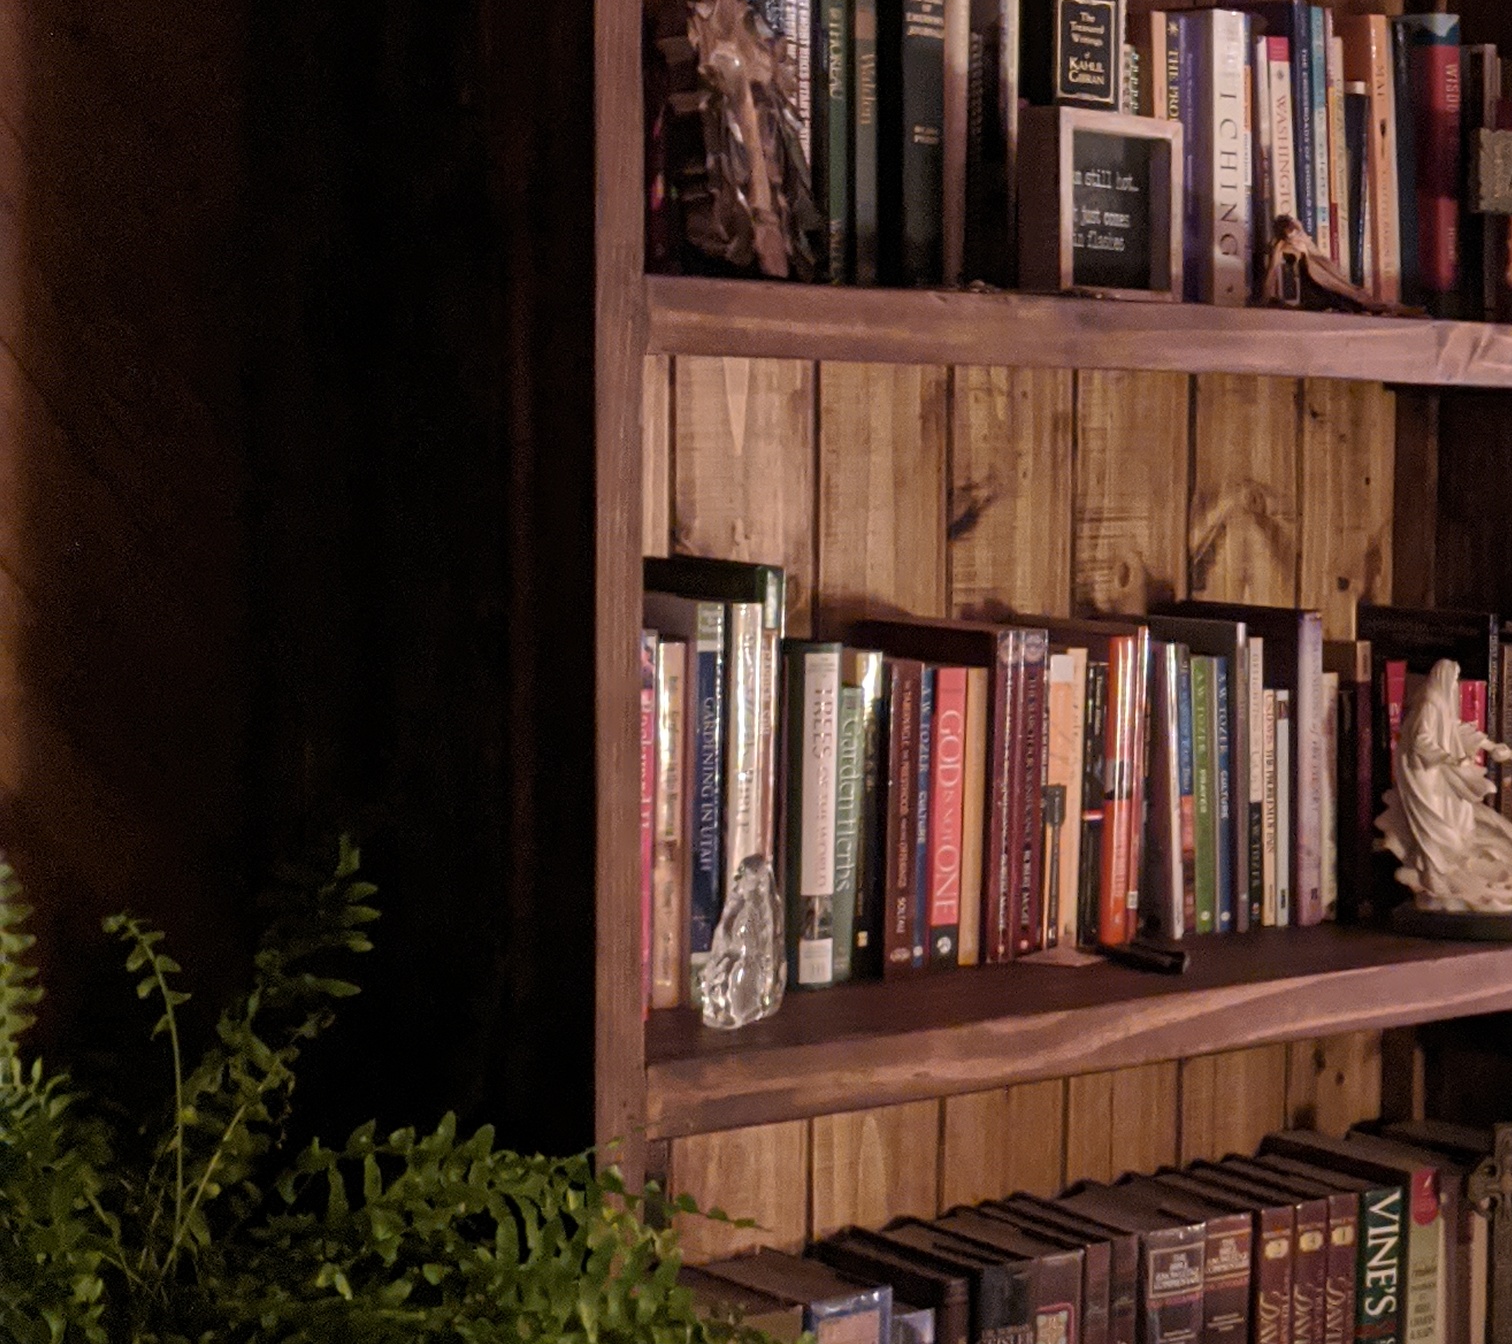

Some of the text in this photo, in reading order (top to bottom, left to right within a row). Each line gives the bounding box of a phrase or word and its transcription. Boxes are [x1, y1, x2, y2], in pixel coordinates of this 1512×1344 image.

[1079, 11, 1096, 23] The
[828, 22, 844, 101] THOREAU
[1068, 56, 1105, 73] KAHLIL
[1068, 69, 1105, 86] GIBRAN
[1167, 49, 1181, 83] THE
[1301, 48, 1309, 68] THE
[858, 50, 875, 126] Walden
[1274, 94, 1293, 216] WASHINGTO
[1303, 145, 1311, 161] OF
[1084, 169, 1112, 189] still
[1219, 118, 1240, 257] CHING
[1080, 206, 1131, 229] just comes
[1086, 229, 1126, 252] flashes
[1305, 209, 1313, 233] AND
[813, 687, 833, 759] TREES
[1196, 706, 1206, 754] TOZER
[1218, 707, 1228, 755] TOZER
[1265, 711, 1275, 745] LEWIS
[919, 723, 930, 774] TOZER
[1265, 749, 1275, 766] THE
[1310, 739, 1321, 760] the
[699, 695, 716, 873] GARDENING IN UTAH
[835, 718, 862, 892] Garden Herbs
[1198, 768, 1208, 814] PRAYER
[1219, 769, 1230, 820] CULTURE
[917, 789, 928, 845] CULTURE
[934, 709, 962, 918] GOD IS NOT ONE
[816, 823, 829, 889] WORLD
[1250, 843, 1261, 889] TOZER
[1364, 1188, 1402, 1318] VINE'S
